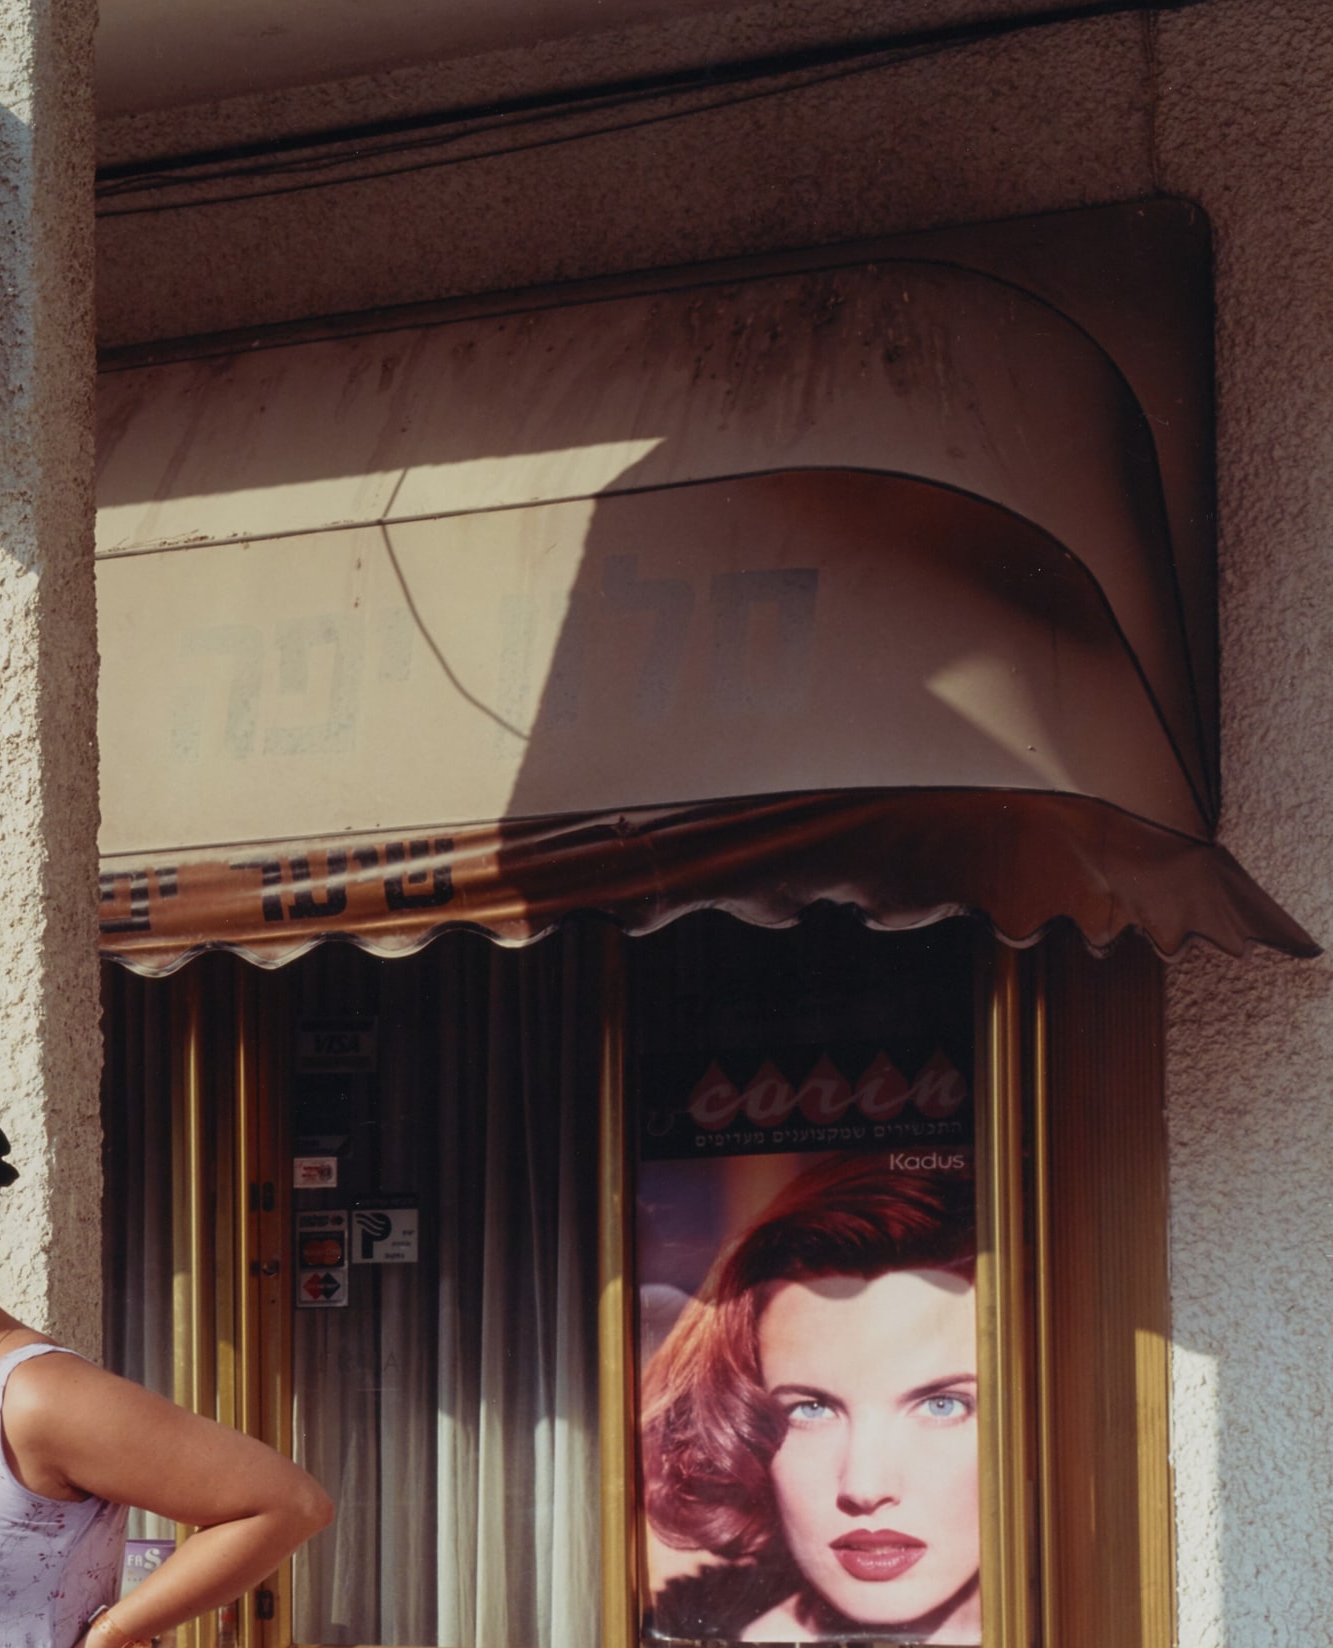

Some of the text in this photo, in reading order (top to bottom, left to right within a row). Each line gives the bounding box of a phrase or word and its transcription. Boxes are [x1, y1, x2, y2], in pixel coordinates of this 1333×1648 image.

[99, 868, 178, 934] יפ
[315, 1033, 361, 1054] VISA
[694, 1120, 963, 1148] התכשירים שמקצוענים מעדיפים
[889, 1153, 965, 1170] Kadus
